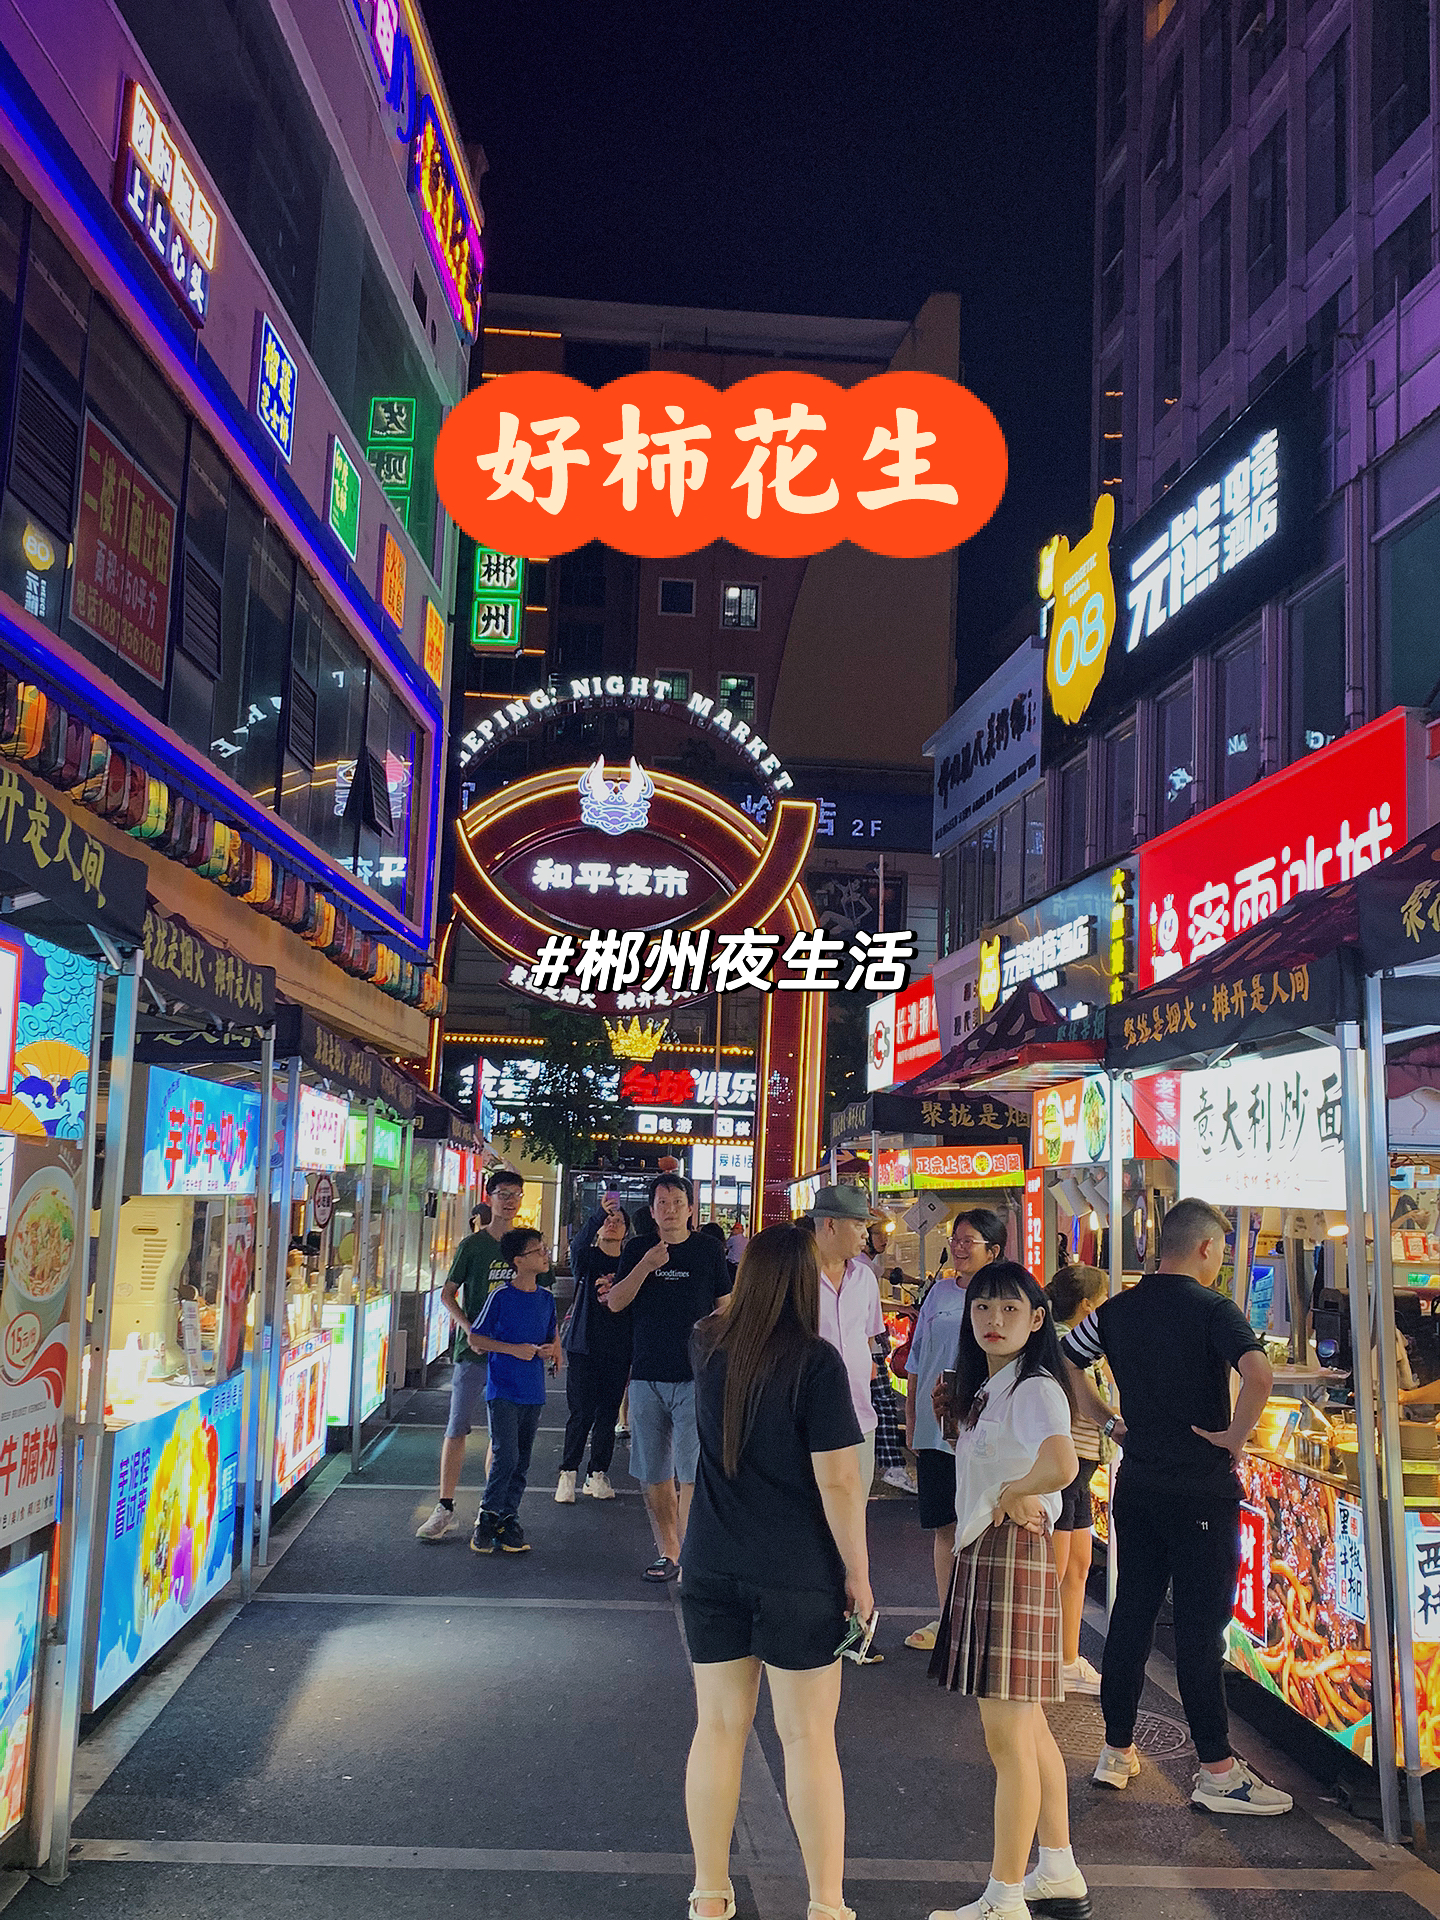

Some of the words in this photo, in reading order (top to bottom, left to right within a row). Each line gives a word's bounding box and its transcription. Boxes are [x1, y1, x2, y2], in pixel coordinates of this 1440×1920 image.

[84, 446, 170, 587] 二楼门面出租
[473, 552, 521, 638] 郴州
[1055, 592, 1106, 686] 08
[570, 676, 672, 699] NIGHT
[687, 692, 795, 794] MARKET
[851, 818, 883, 837] 2F
[531, 858, 690, 899] 和平夜市
[1193, 1071, 1344, 1154] 意大利炒面
[0, 1423, 57, 1497] 牛腩粉
